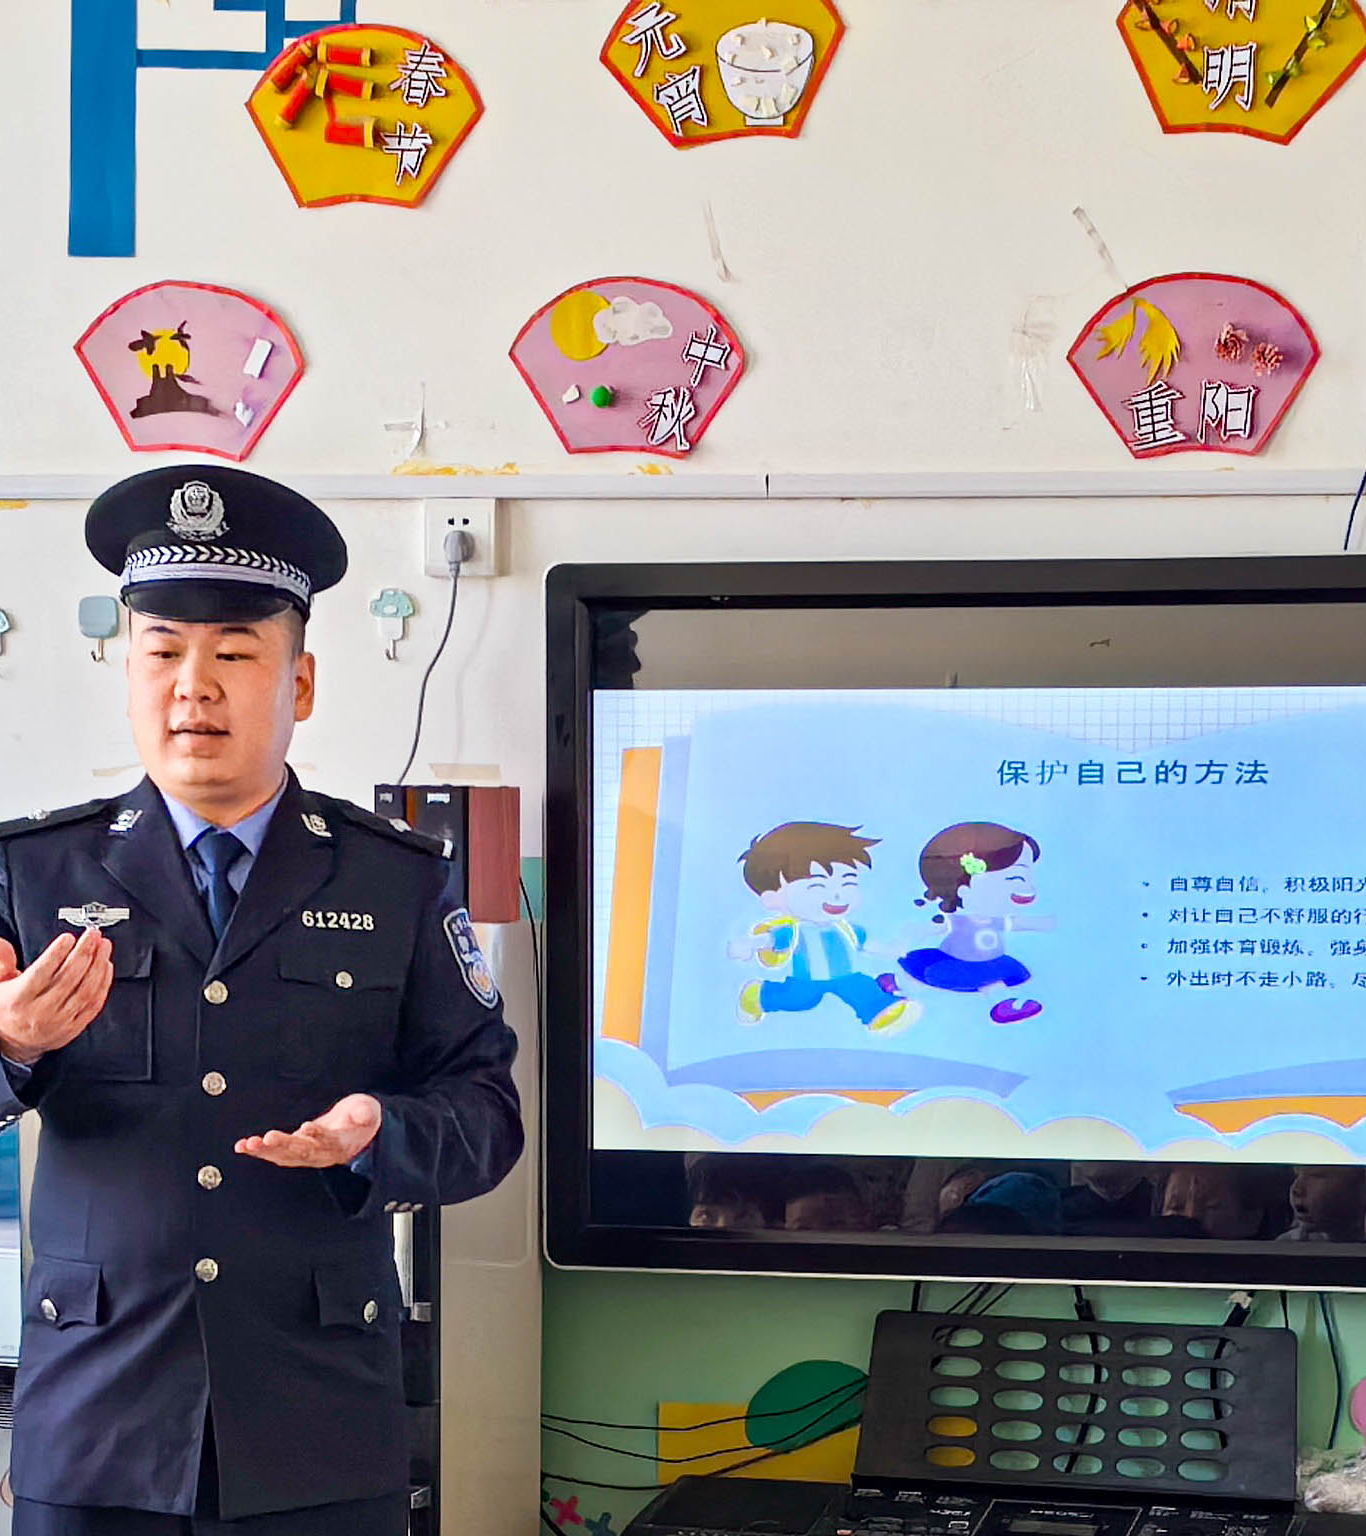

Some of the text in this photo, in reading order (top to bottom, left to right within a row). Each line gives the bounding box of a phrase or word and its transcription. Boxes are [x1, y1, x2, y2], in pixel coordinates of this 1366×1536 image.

[381, 41, 447, 185] 春节
[624, 3, 708, 135] 元宵
[636, 324, 731, 450] 中秋
[1122, 379, 1259, 448] 重阳
[996, 759, 1269, 786] 保护自己的方法
[301, 910, 375, 931] 612428
